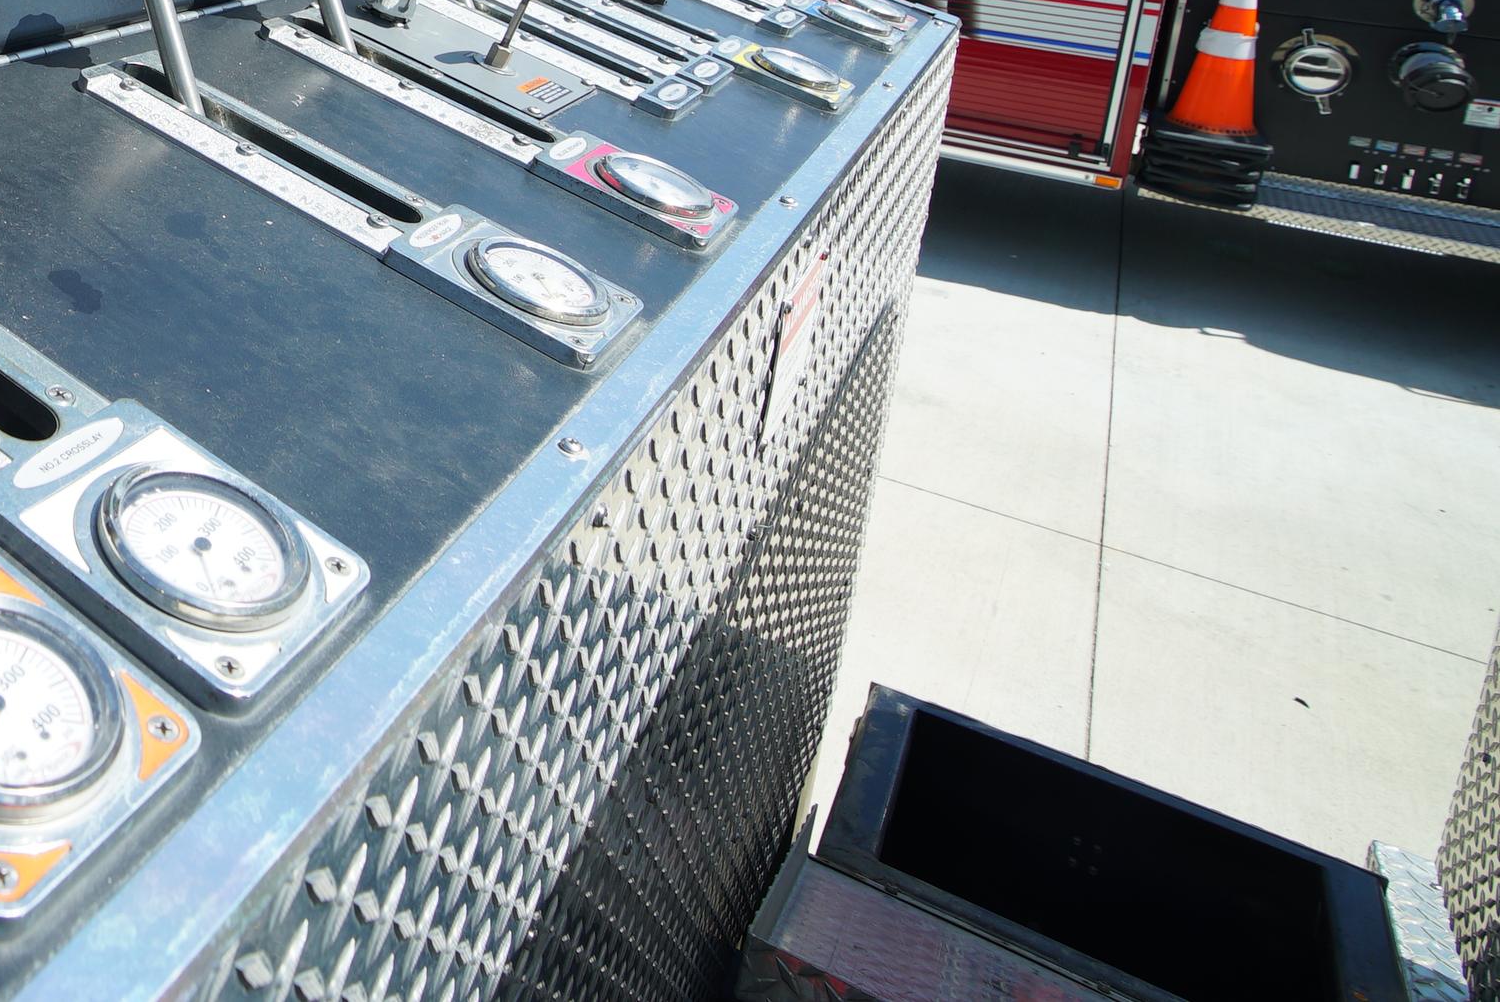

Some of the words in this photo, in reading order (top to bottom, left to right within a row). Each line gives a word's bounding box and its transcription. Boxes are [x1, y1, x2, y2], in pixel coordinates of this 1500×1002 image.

[59, 431, 104, 461] CROSSLAY
[153, 511, 178, 533] 200
[197, 517, 222, 538] 300
[155, 544, 180, 565] 100
[233, 546, 257, 567] 400
[32, 702, 61, 730] 400
